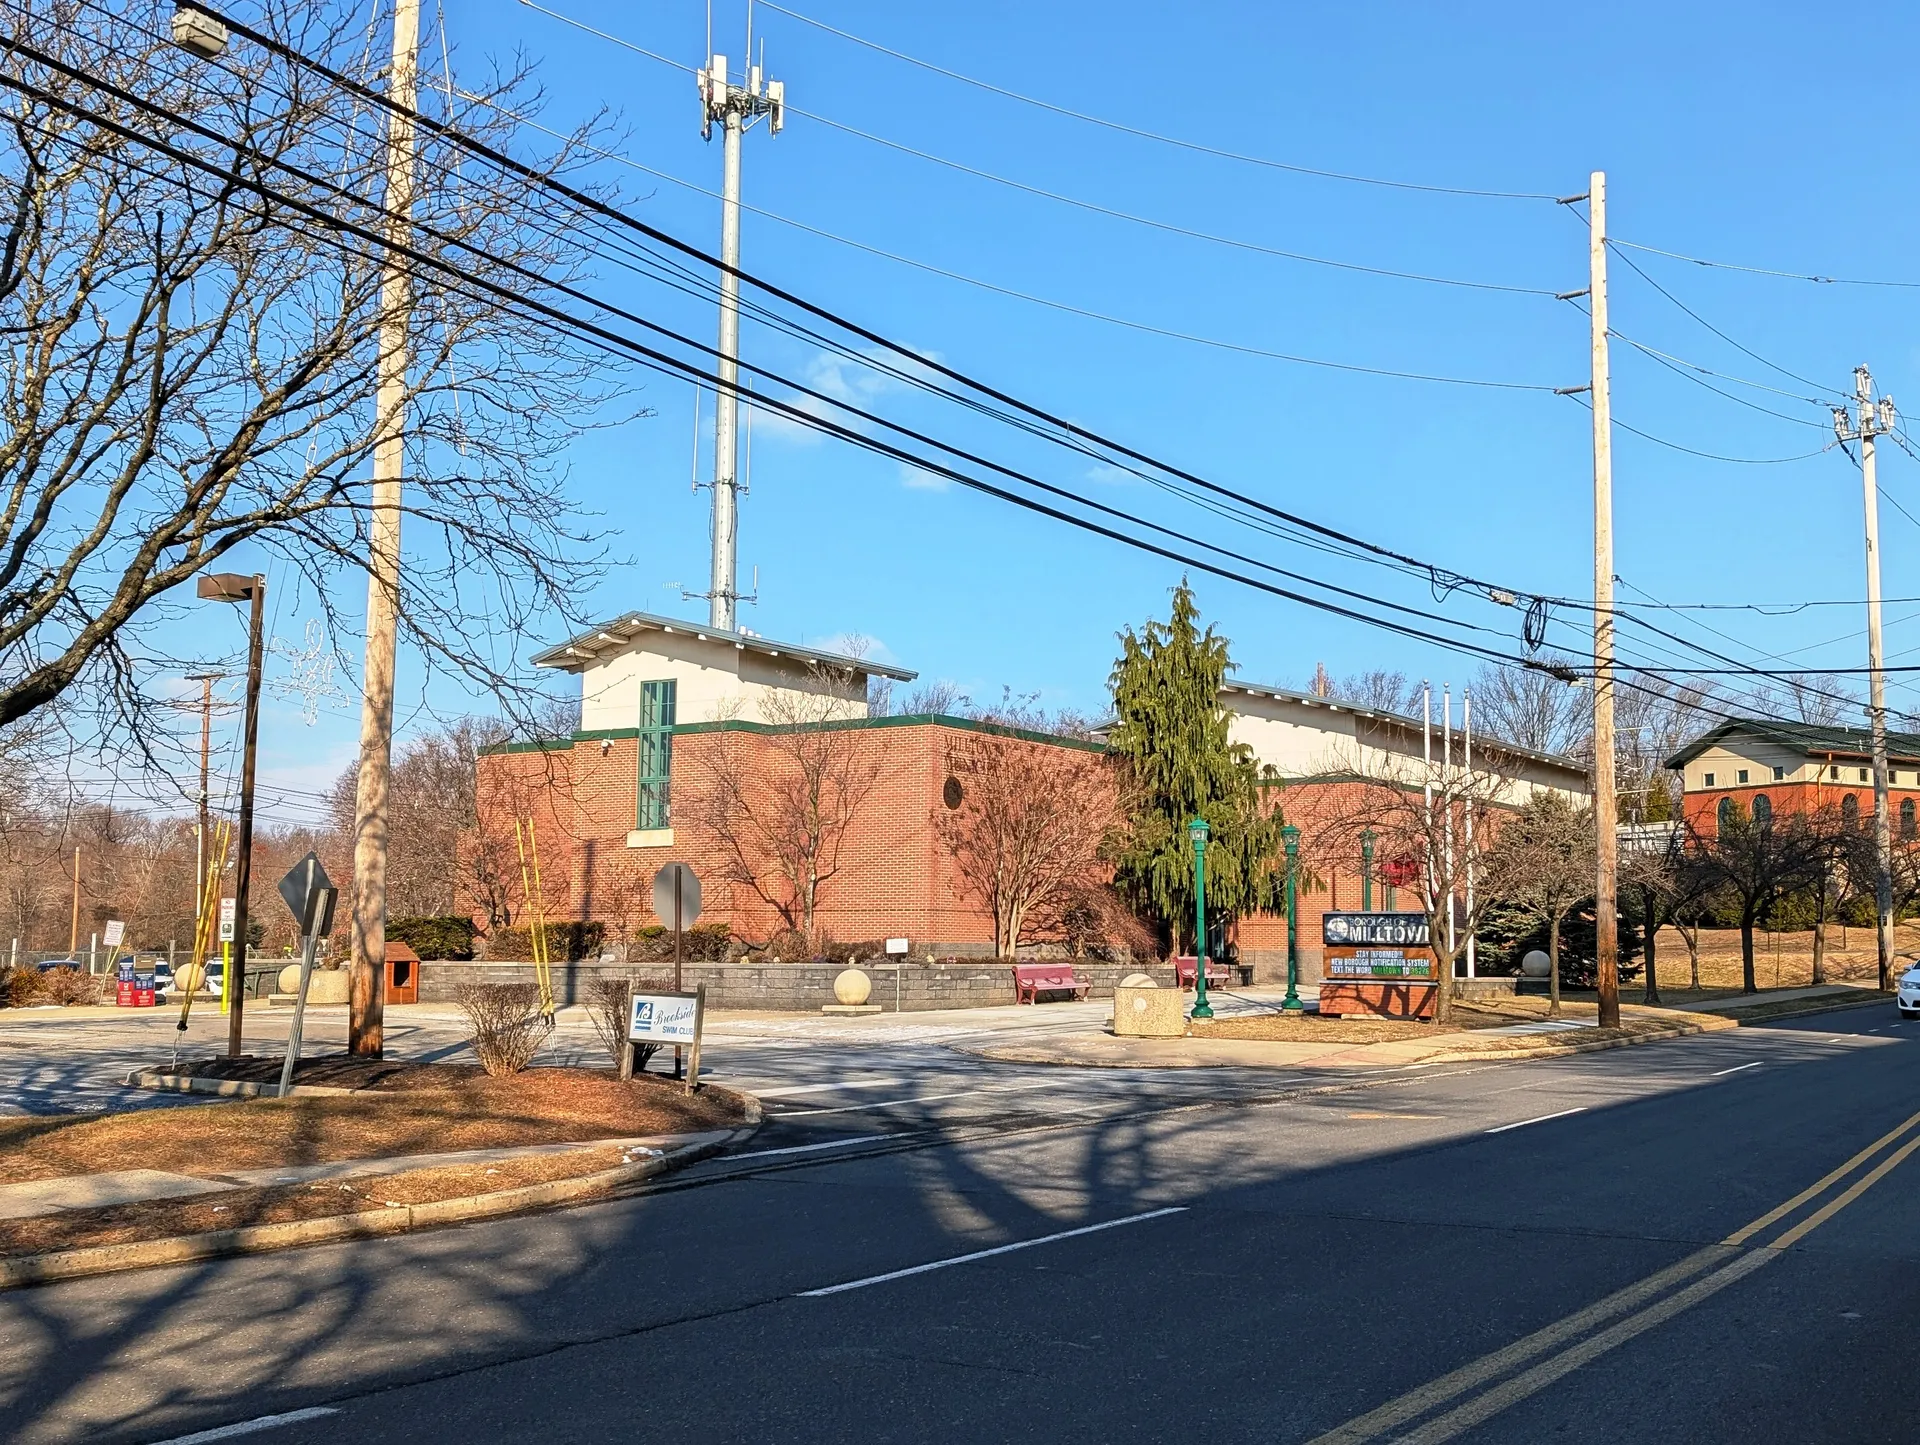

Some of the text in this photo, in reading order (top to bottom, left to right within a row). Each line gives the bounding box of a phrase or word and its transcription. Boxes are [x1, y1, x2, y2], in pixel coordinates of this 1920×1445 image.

[1349, 917, 1407, 926] BOROUGH OF
[1356, 950, 1369, 958] STAY
[1331, 958, 1343, 966] NEW
[1344, 958, 1369, 966] BOROUGH
[1407, 959, 1429, 967] SYSTEM
[1331, 966, 1344, 974] TEXT
[1345, 966, 1355, 974] THE
[1356, 966, 1372, 974] WORD
[662, 1026, 694, 1036] SWIM CLUB
